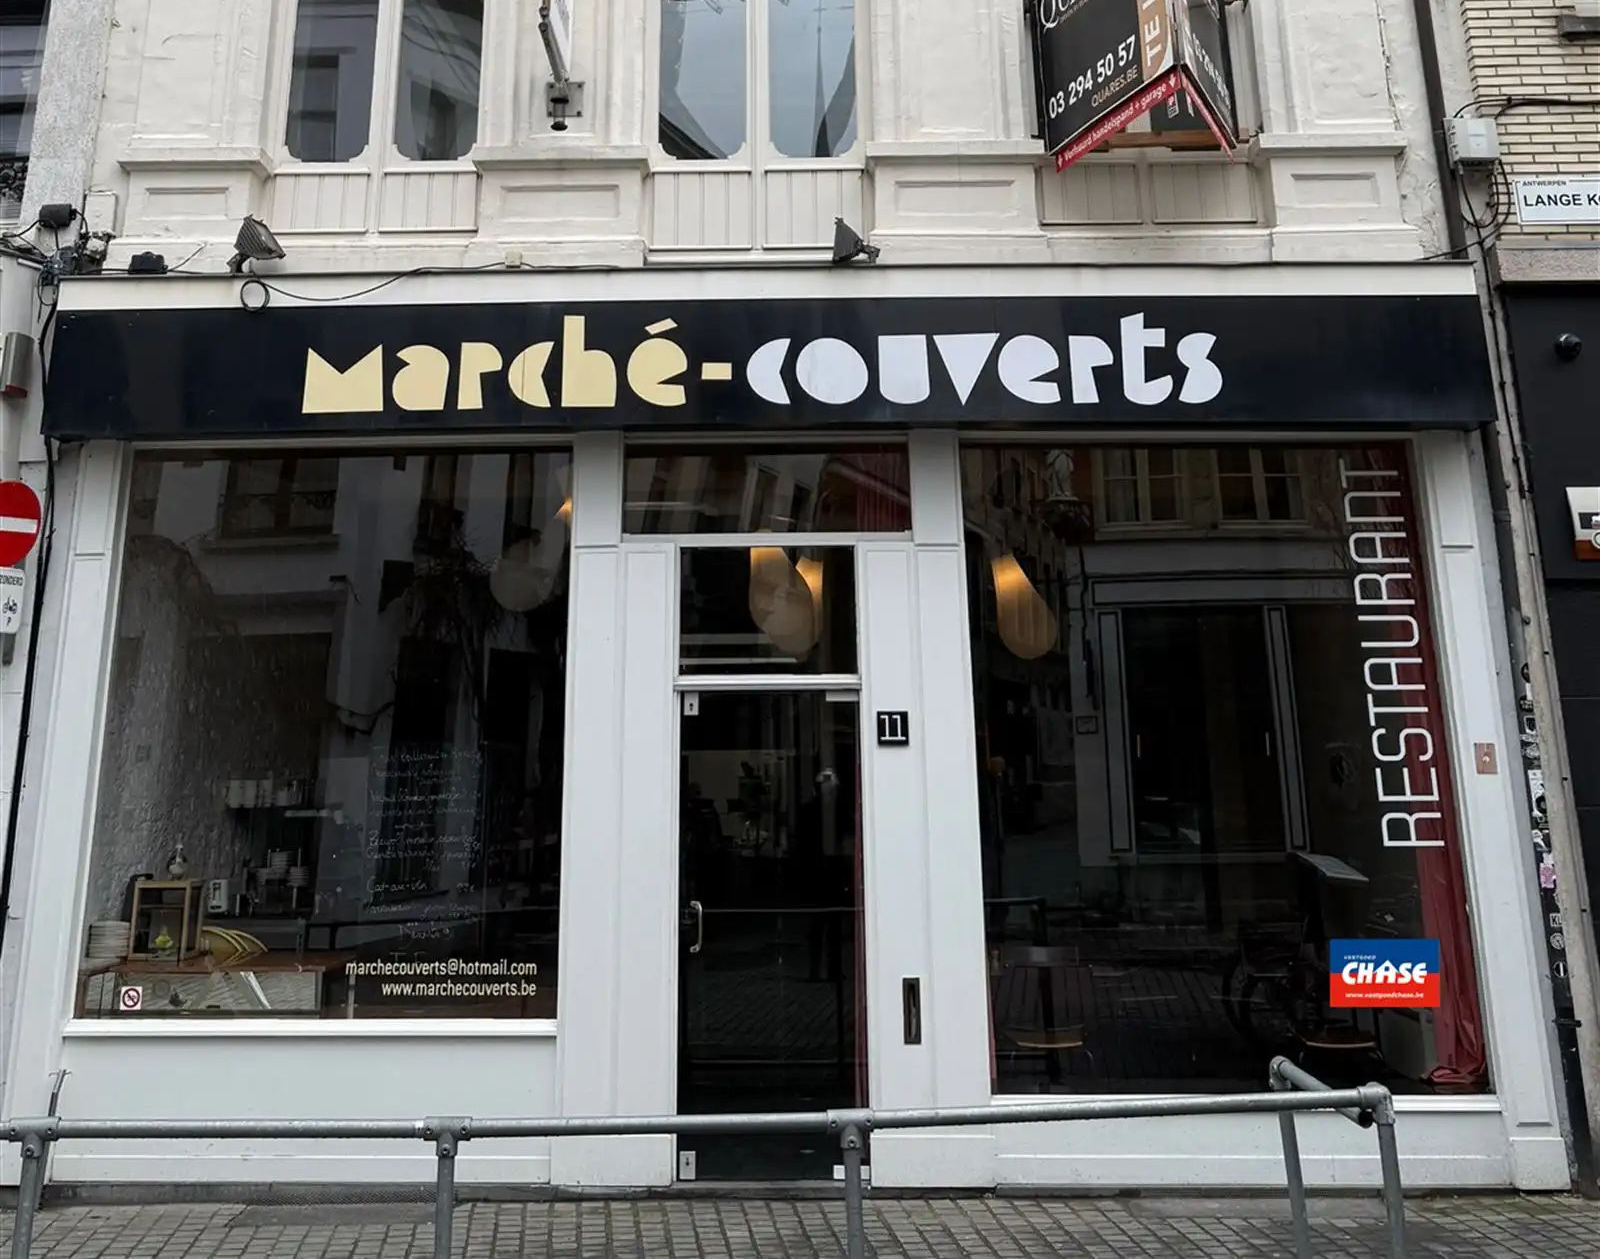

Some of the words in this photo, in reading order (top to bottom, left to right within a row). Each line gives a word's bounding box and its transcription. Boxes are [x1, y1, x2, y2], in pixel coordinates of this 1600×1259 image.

[1143, 16, 1162, 67] TE
[1048, 91, 1065, 120] 03
[1068, 74, 1094, 105] 294
[1096, 55, 1116, 87] 50
[1117, 35, 1137, 68] 57
[1090, 64, 1139, 109] QUARES.BE
[1140, 84, 1167, 116] garage
[1523, 193, 1582, 207] LANGE
[1588, 193, 1600, 206] K
[1338, 458, 1445, 850] RESTAURANT
[879, 714, 906, 741] 11
[345, 958, 537, 976] marchecouverts@hotmail.com
[1342, 959, 1427, 985] CHASE
[381, 980, 537, 997] www.marchecouverts.be
